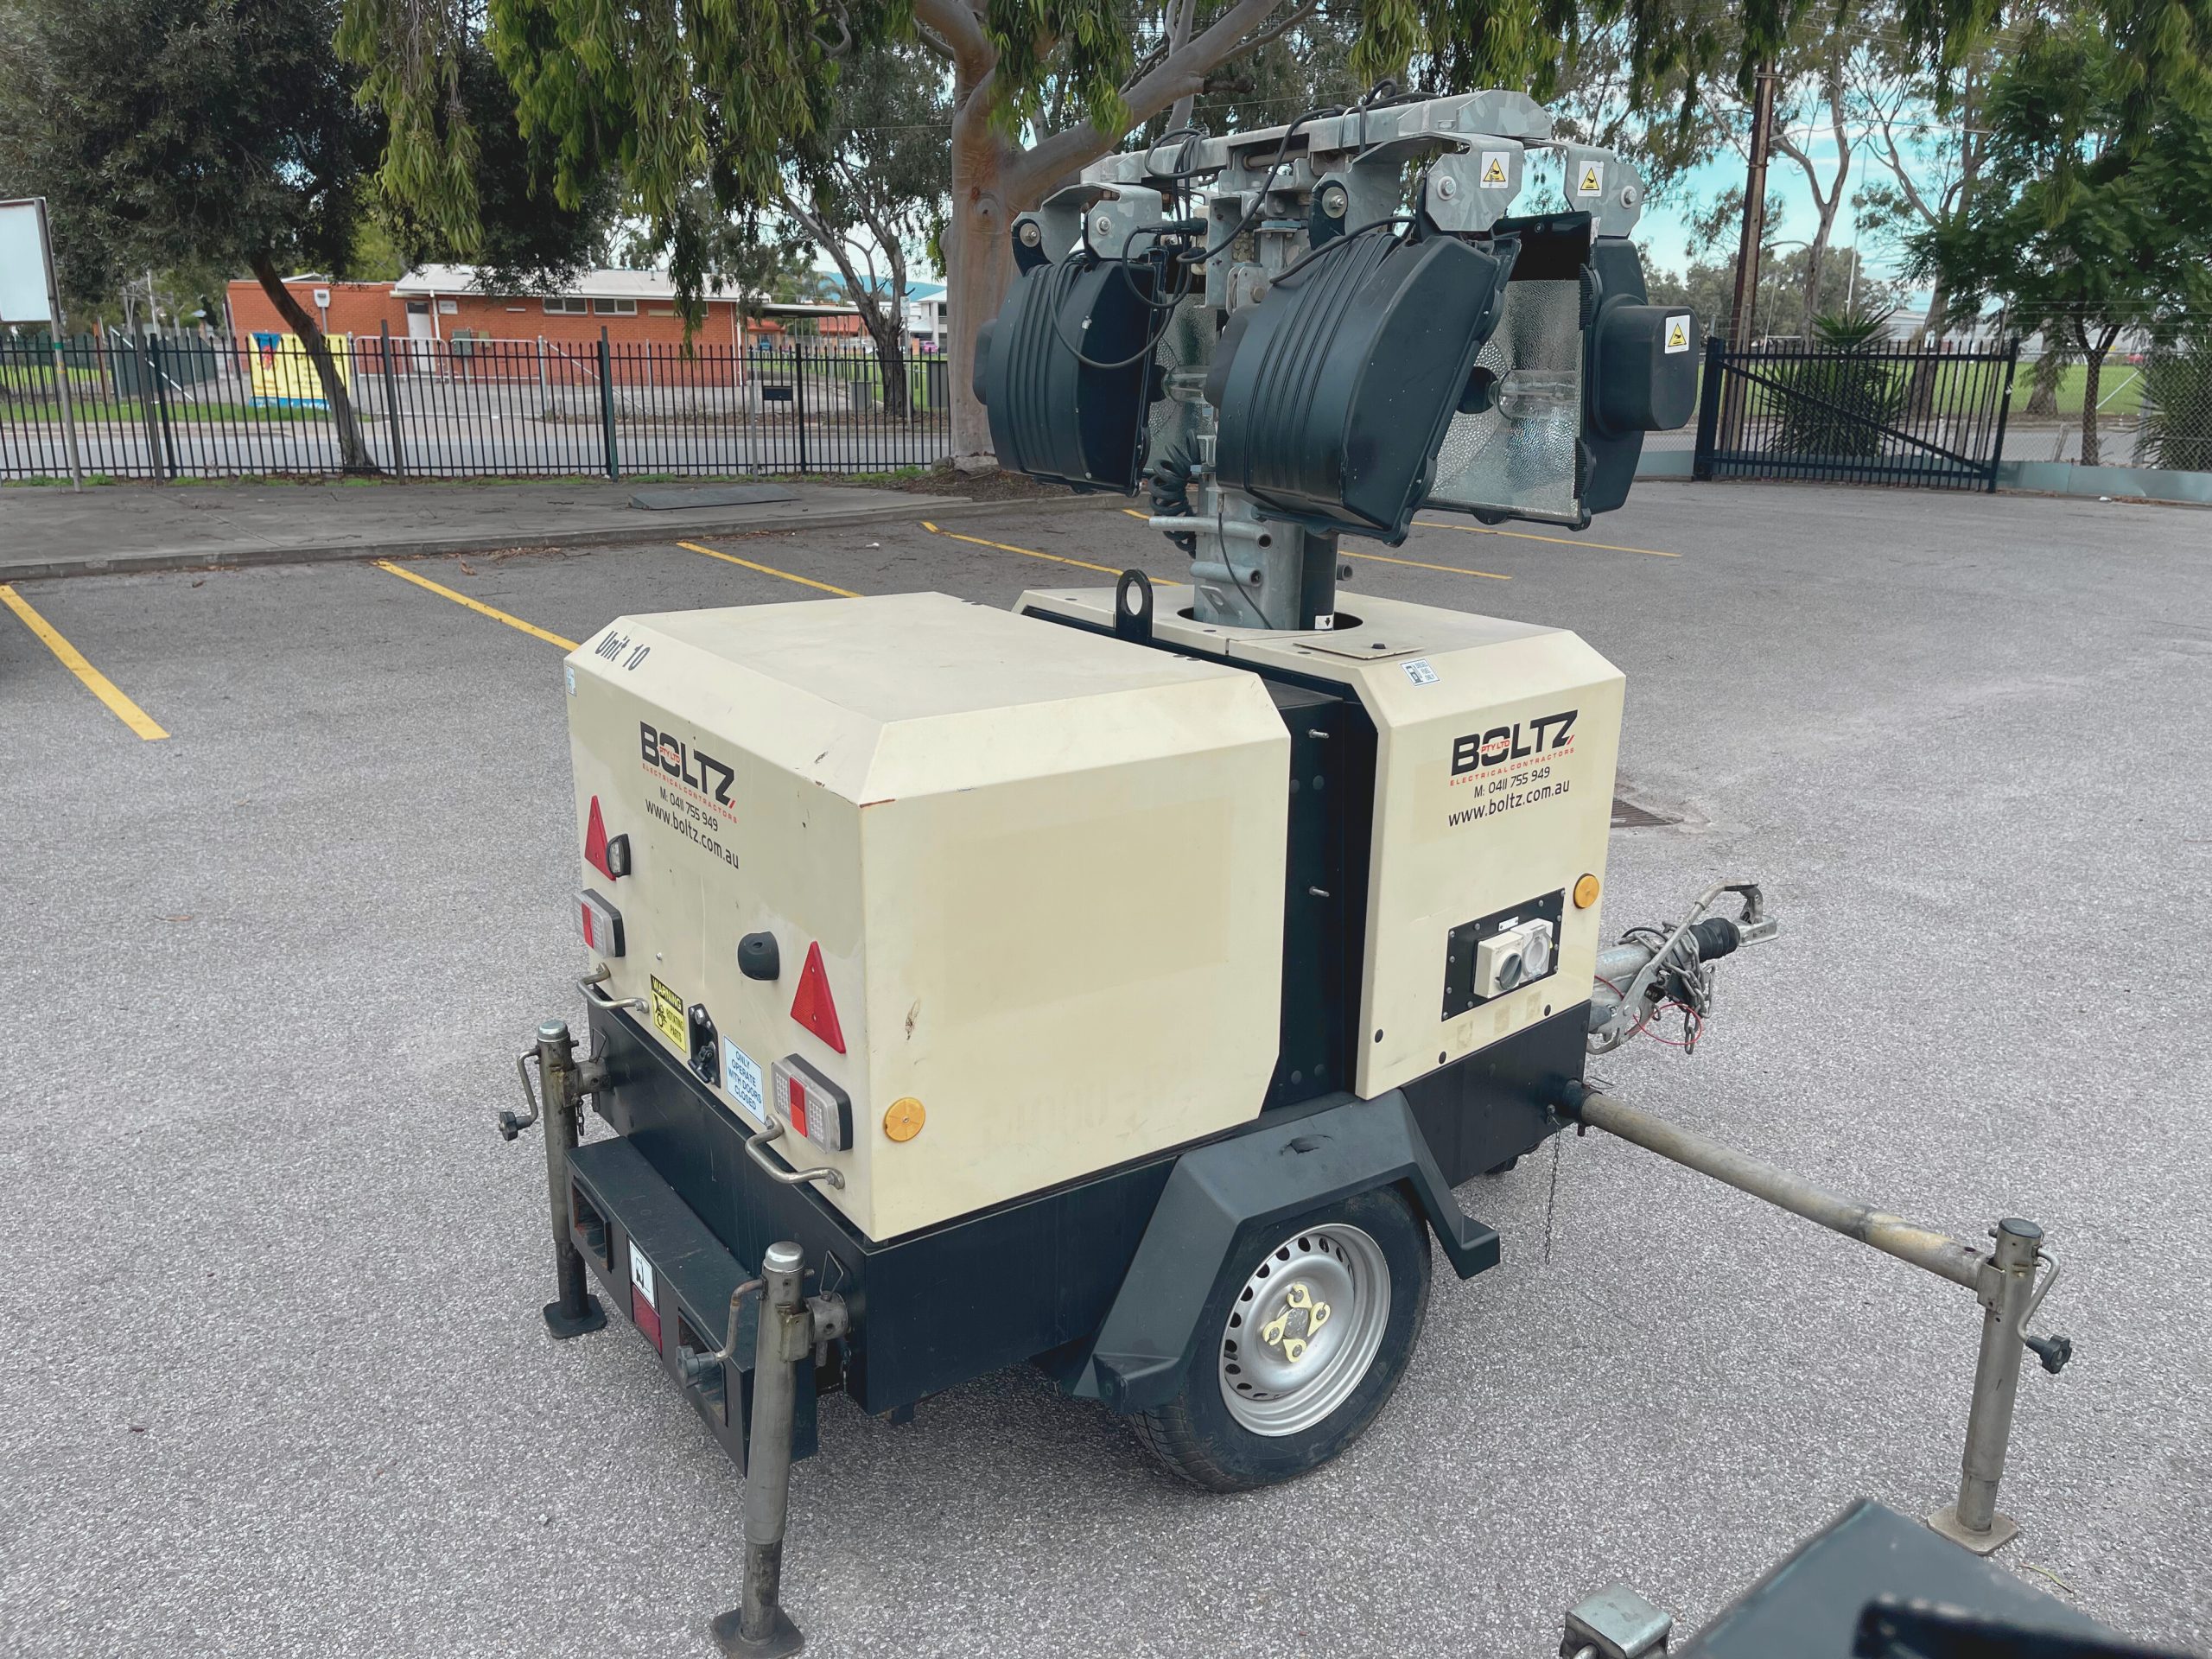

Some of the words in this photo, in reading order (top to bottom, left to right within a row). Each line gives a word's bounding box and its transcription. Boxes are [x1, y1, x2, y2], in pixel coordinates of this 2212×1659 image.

[594, 630, 631, 662] Unit
[622, 644, 651, 671] 10
[659, 746, 671, 757] PTY
[671, 752, 681, 764] LTD
[1451, 709, 1579, 776] BOLTZ
[1480, 742, 1496, 753] PTY
[1496, 740, 1510, 751] LTD
[640, 721, 735, 808] BOLTZ
[1450, 767, 1508, 786] ELECTRICAL
[1510, 747, 1575, 771] CONTRACTORS
[1474, 785, 1485, 798] M:
[1488, 779, 1508, 794] 0411
[1510, 772, 1529, 788] 755
[1531, 766, 1551, 782] 949
[642, 763, 683, 790] ELECTRICAL
[683, 787, 738, 823] CONTRACTORS
[659, 786, 669, 802] M:
[670, 794, 684, 811] 0411
[685, 802, 700, 821] 755
[702, 812, 718, 831] 949
[1448, 779, 1570, 827] www.boltz.com.au
[645, 799, 740, 869] www.boltz.com.au
[652, 977, 682, 1010] WARNING
[731, 1058, 757, 1087] OPERATE
[735, 1051, 750, 1068] ONLY
[728, 1066, 741, 1084] WITH
[742, 1079, 762, 1104] DOORS
[734, 1084, 757, 1110] CLOSED
